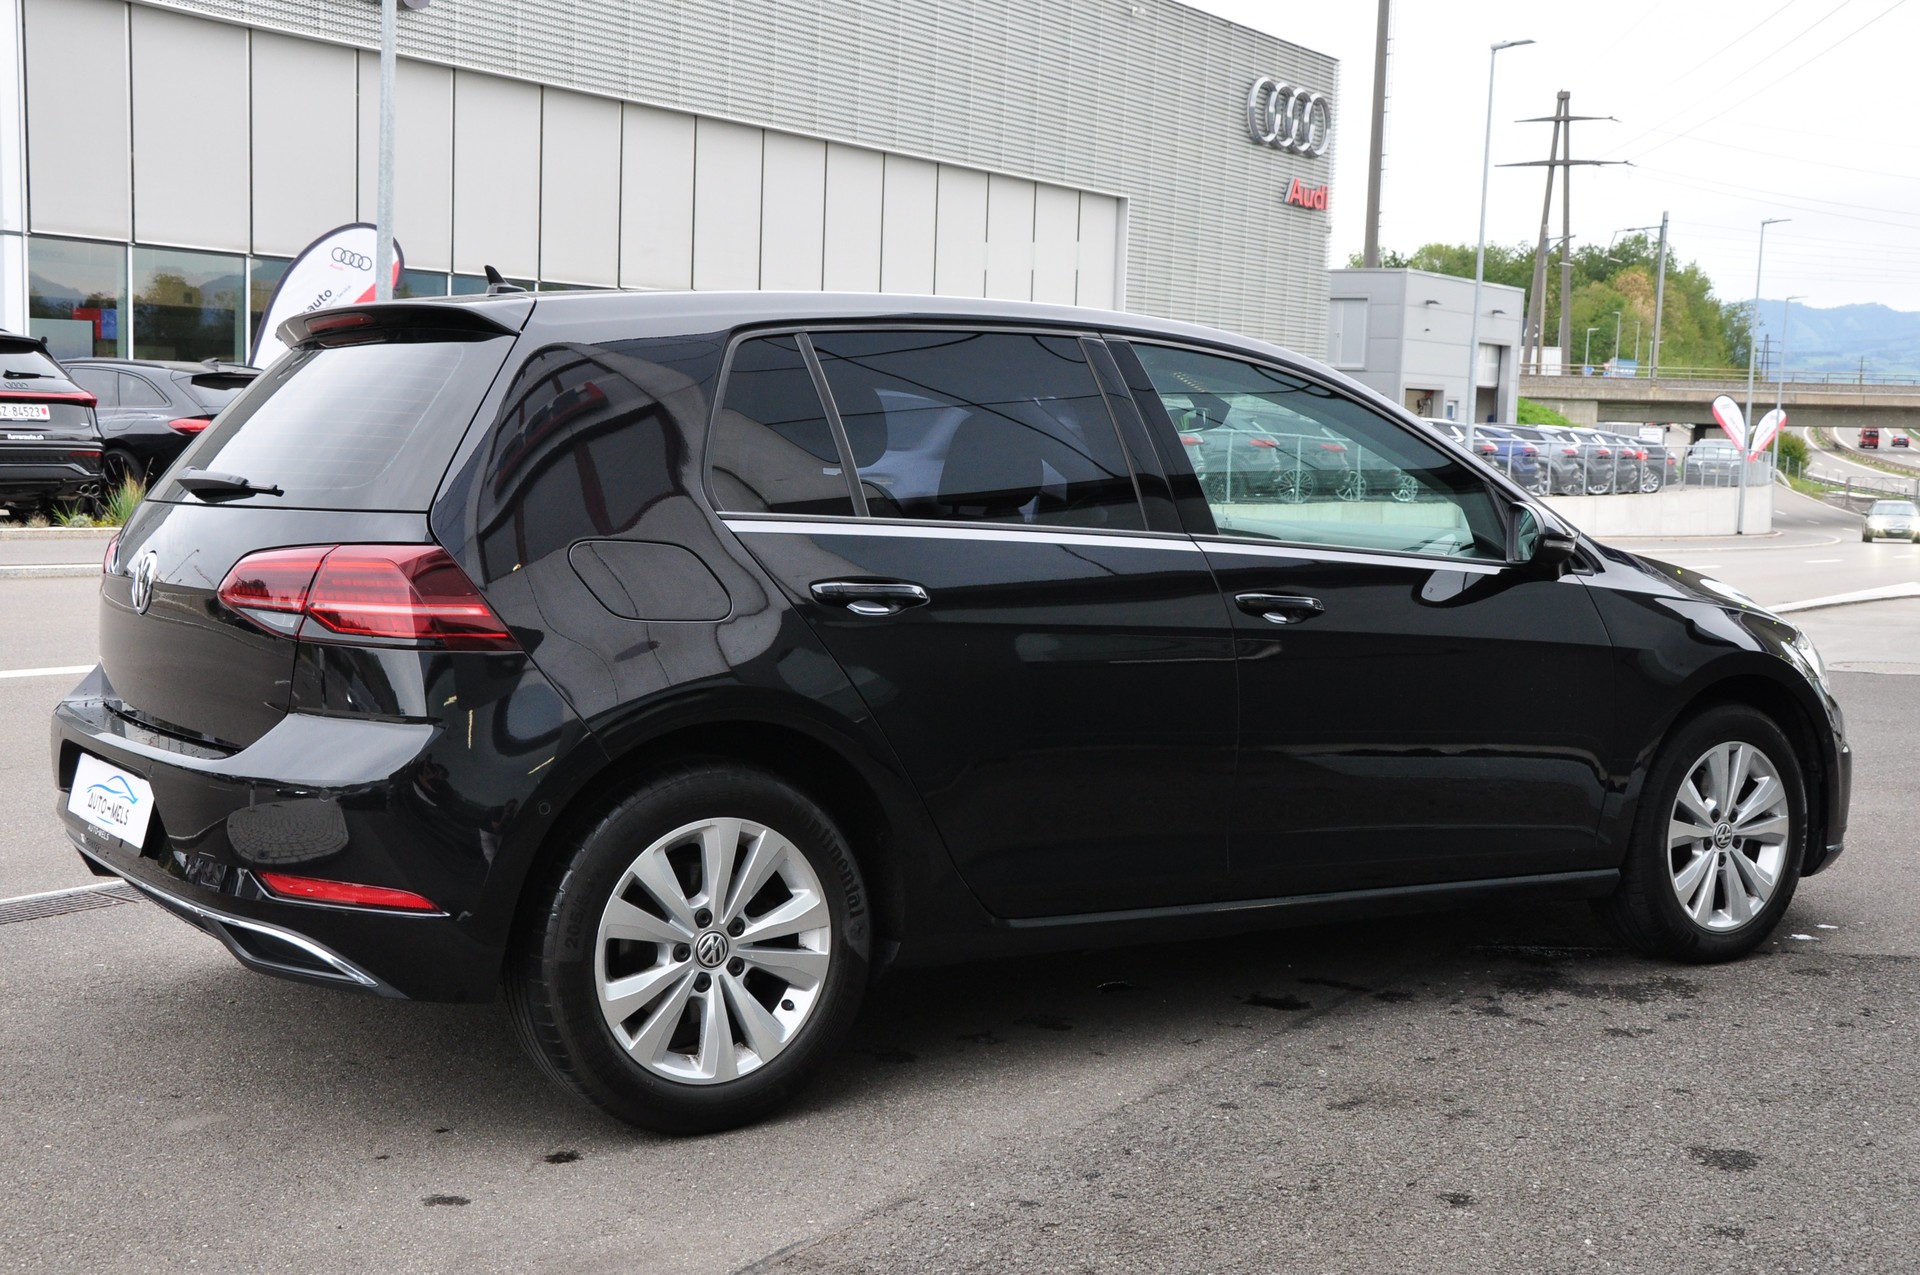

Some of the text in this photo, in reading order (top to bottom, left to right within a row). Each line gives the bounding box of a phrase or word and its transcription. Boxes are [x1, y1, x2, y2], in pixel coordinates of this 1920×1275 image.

[1286, 177, 1329, 210] Audi
[303, 289, 333, 314] auto
[87, 792, 130, 826] AUTO-MELS
